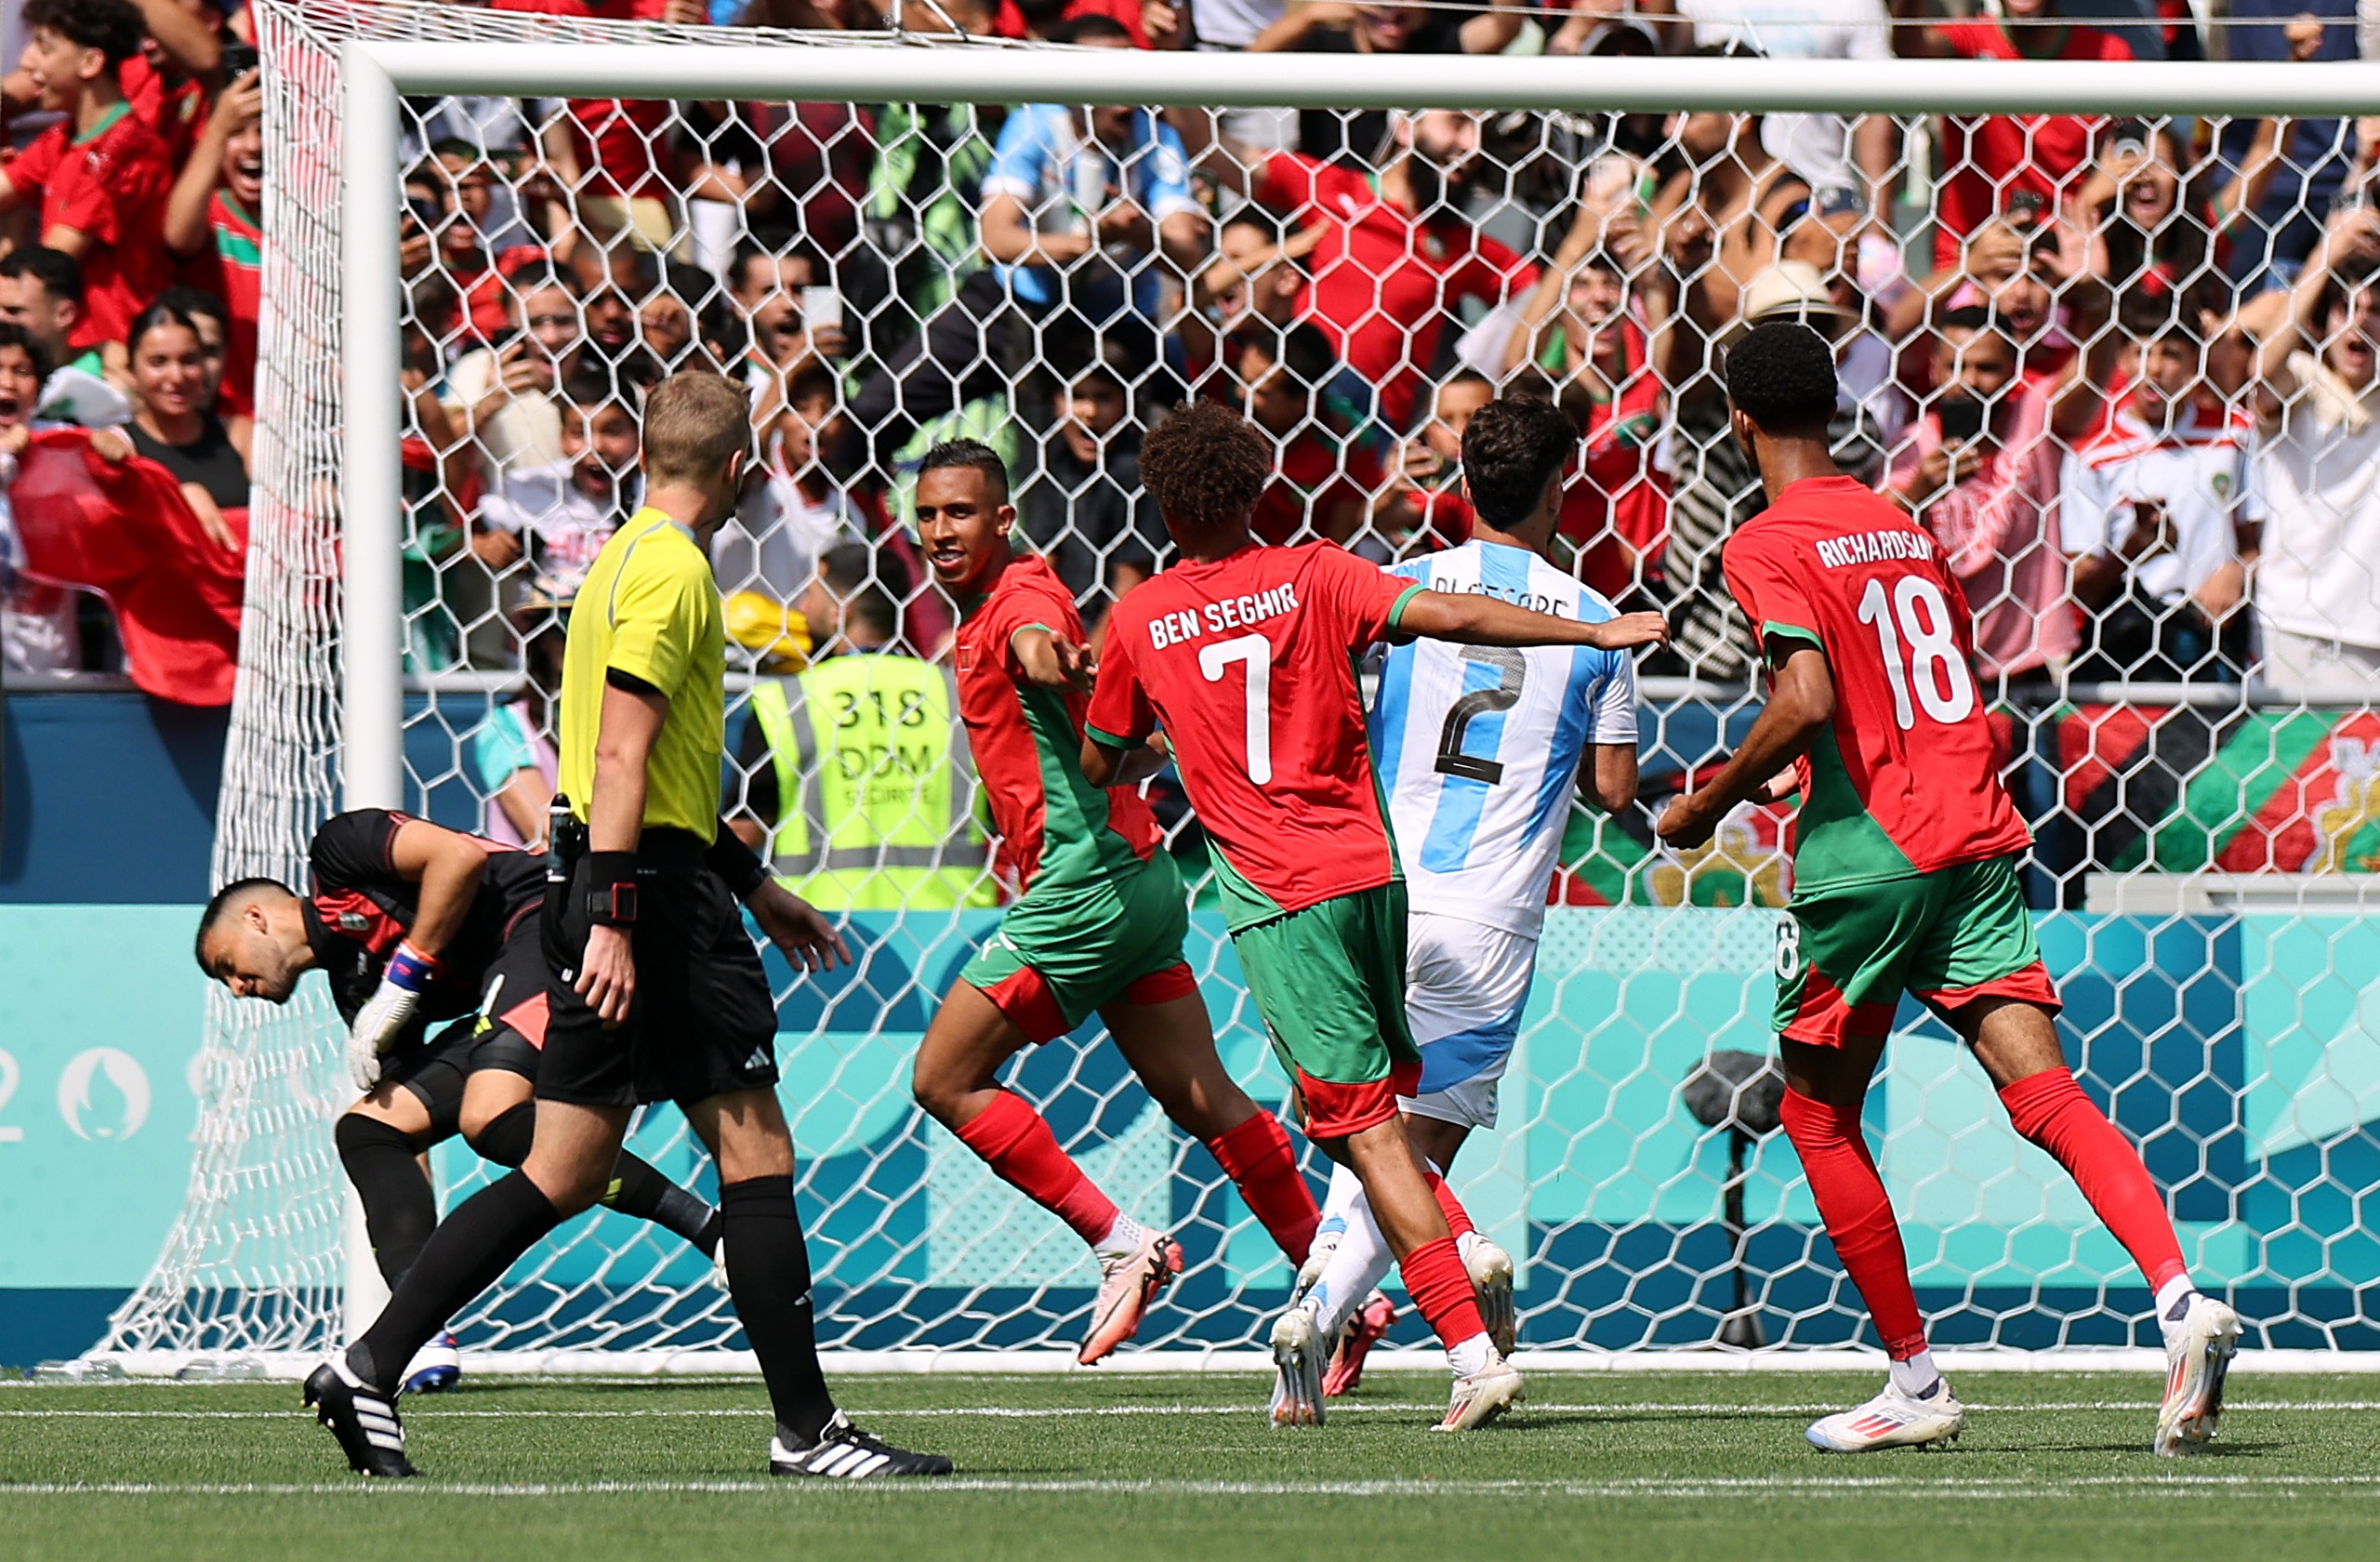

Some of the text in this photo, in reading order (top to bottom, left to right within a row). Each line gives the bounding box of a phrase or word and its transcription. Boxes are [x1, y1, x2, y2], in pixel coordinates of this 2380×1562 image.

[1149, 582, 1300, 650] BEN SEGHIR
[1858, 575, 1974, 730] 18
[832, 689, 925, 728] 318
[1198, 633, 1272, 785] 7
[1435, 644, 1527, 786] 2
